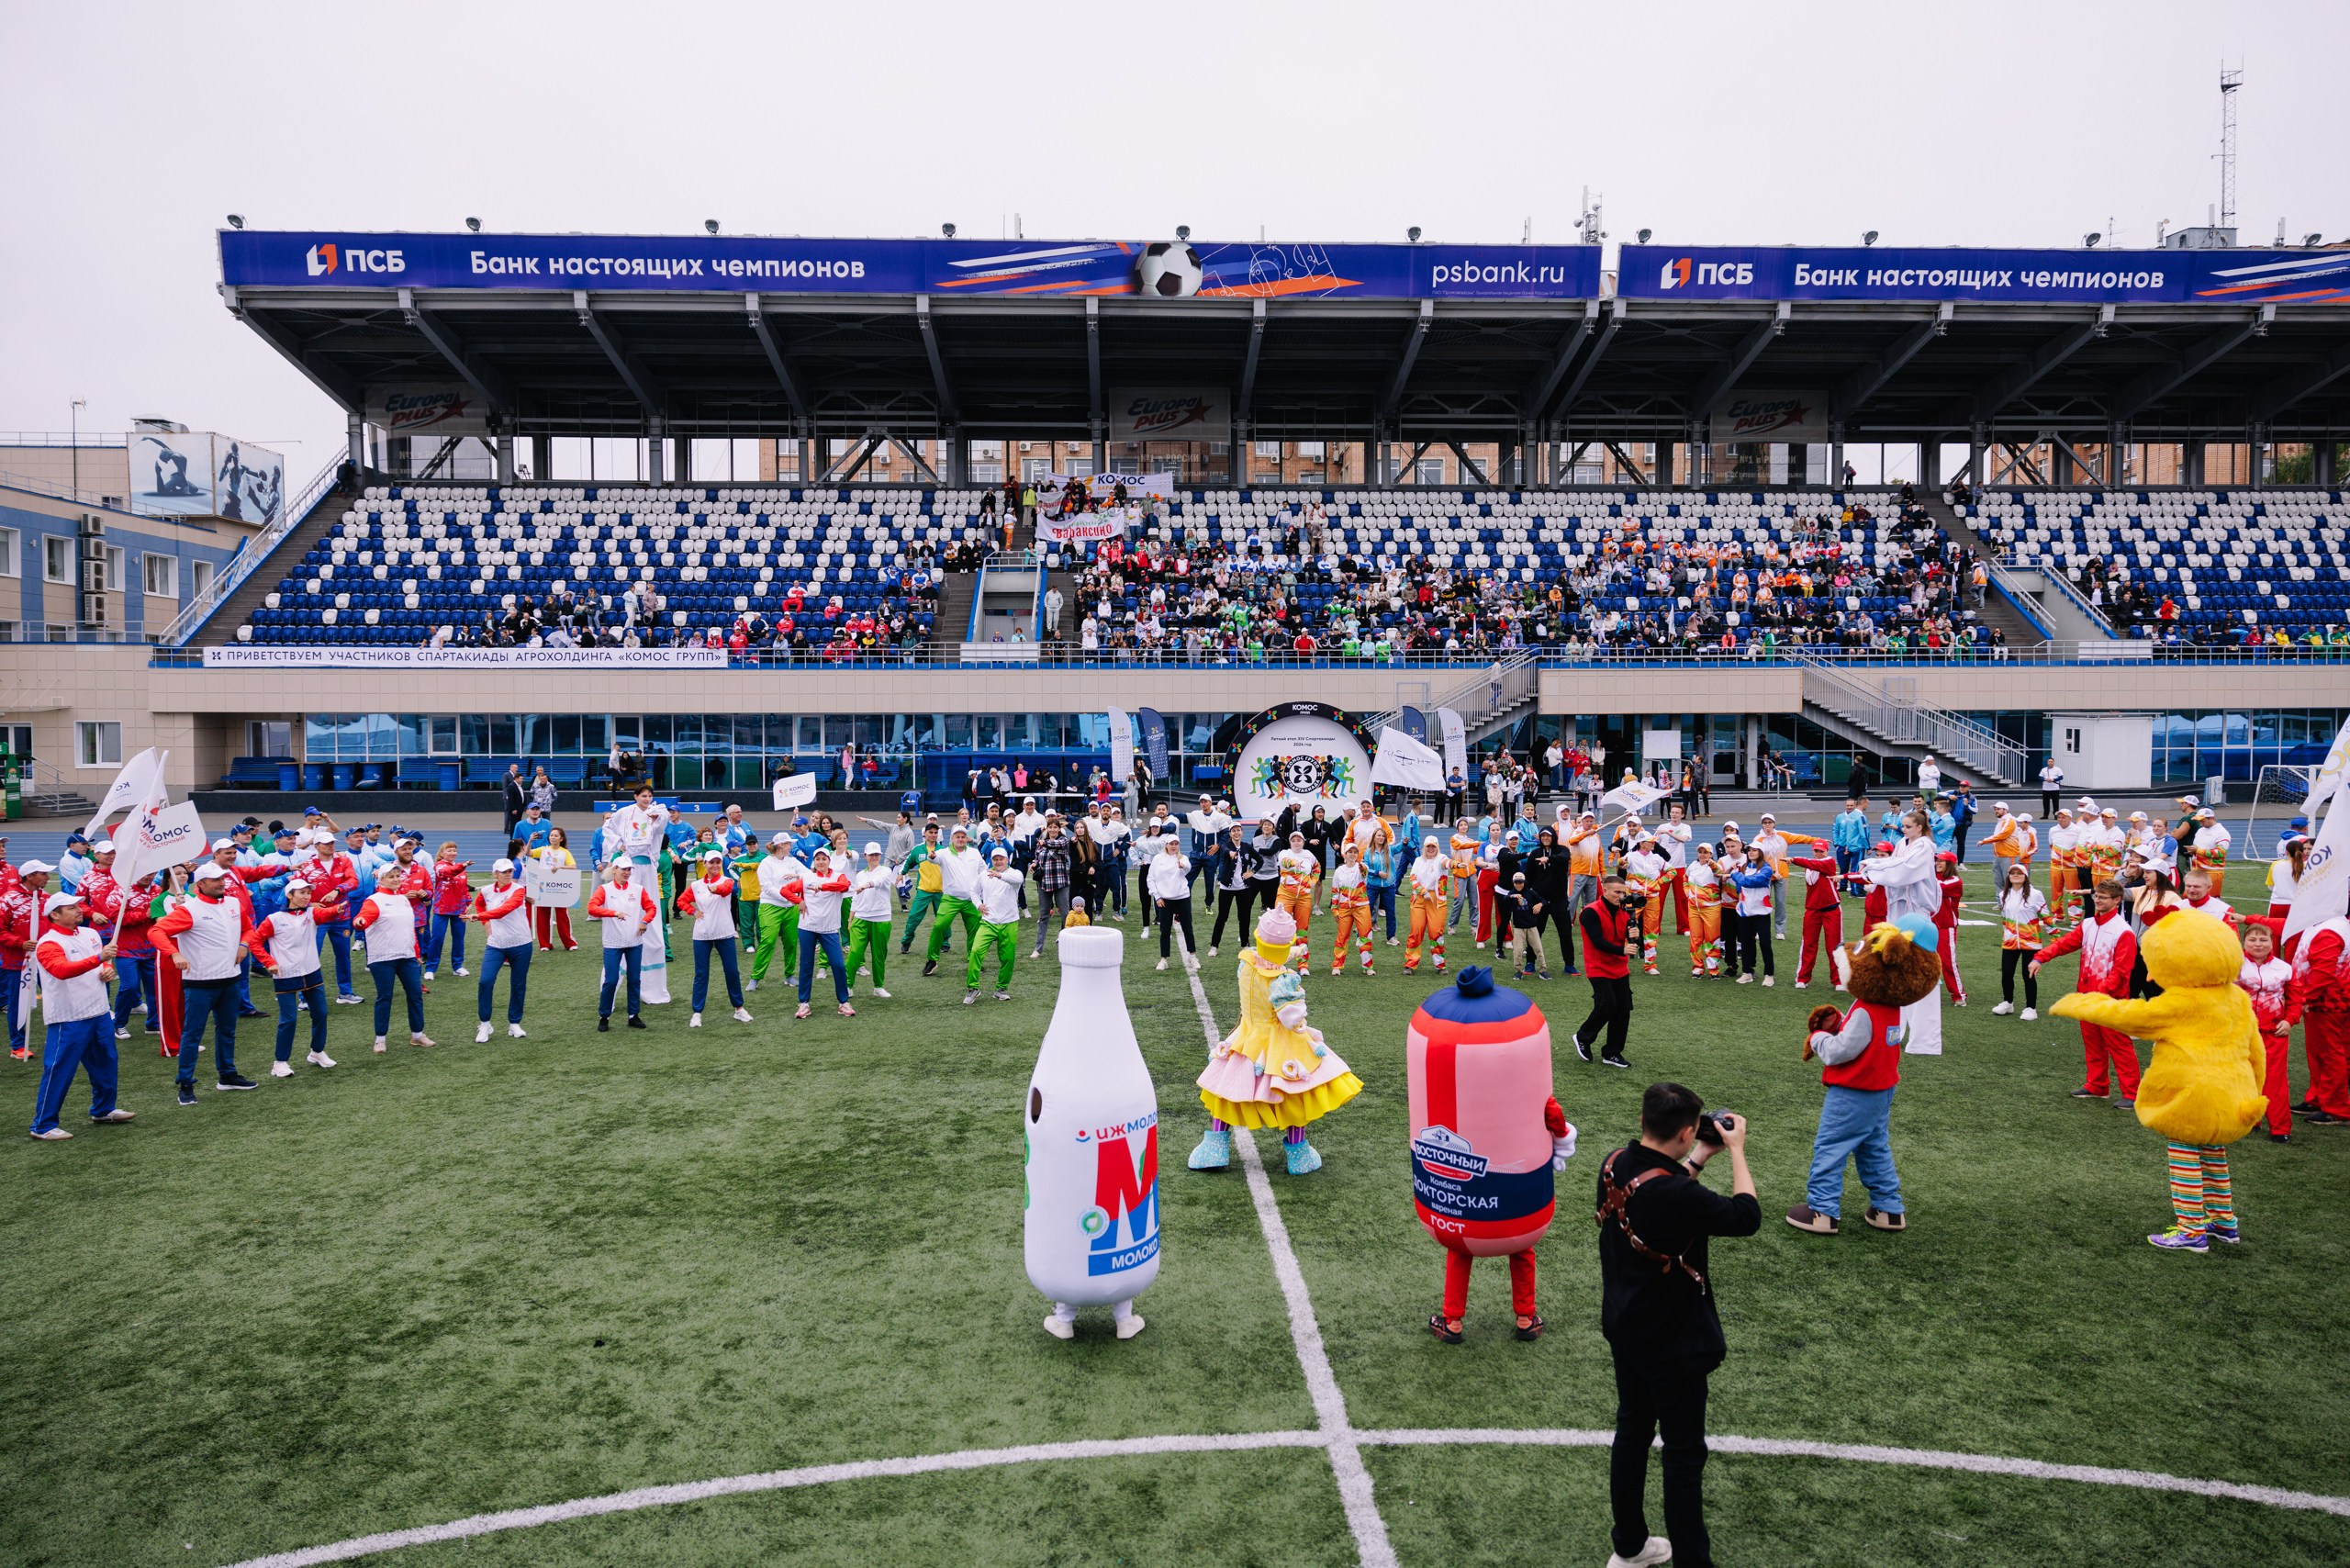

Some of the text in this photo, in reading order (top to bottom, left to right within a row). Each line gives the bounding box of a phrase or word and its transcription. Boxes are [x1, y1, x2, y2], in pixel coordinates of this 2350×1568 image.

[346, 250, 406, 273] ПСБ
[470, 251, 866, 280] Банк настоящих чемпионов
[1432, 260, 1565, 288] psbank.ru
[1697, 263, 1754, 286] ПСБ
[1795, 263, 2165, 290] Банк настоящих чемпионов
[227, 651, 722, 663] ПРИВЕТСТВУЕМ УЧАСТНИКОВ СПАРТАКИАДЫ АГРОХОЛДИНГА «КОМОС ГРУПП»
[1287, 756, 1320, 768] КОМОС ГРУПП
[789, 783, 811, 792] КОМОС
[1286, 779, 1321, 793] СПАРТАКИАДА
[610, 803, 618, 812] 2
[693, 804, 700, 812] 3
[151, 834, 185, 850] ОСТОЧНЫЙ
[153, 824, 192, 843] ОМОС
[1429, 1175, 1462, 1193] Колбаса
[1431, 1202, 1462, 1216] вареная
[1430, 1214, 1466, 1234] ГОСТ
[1111, 1237, 1158, 1270] МОЛОКО
